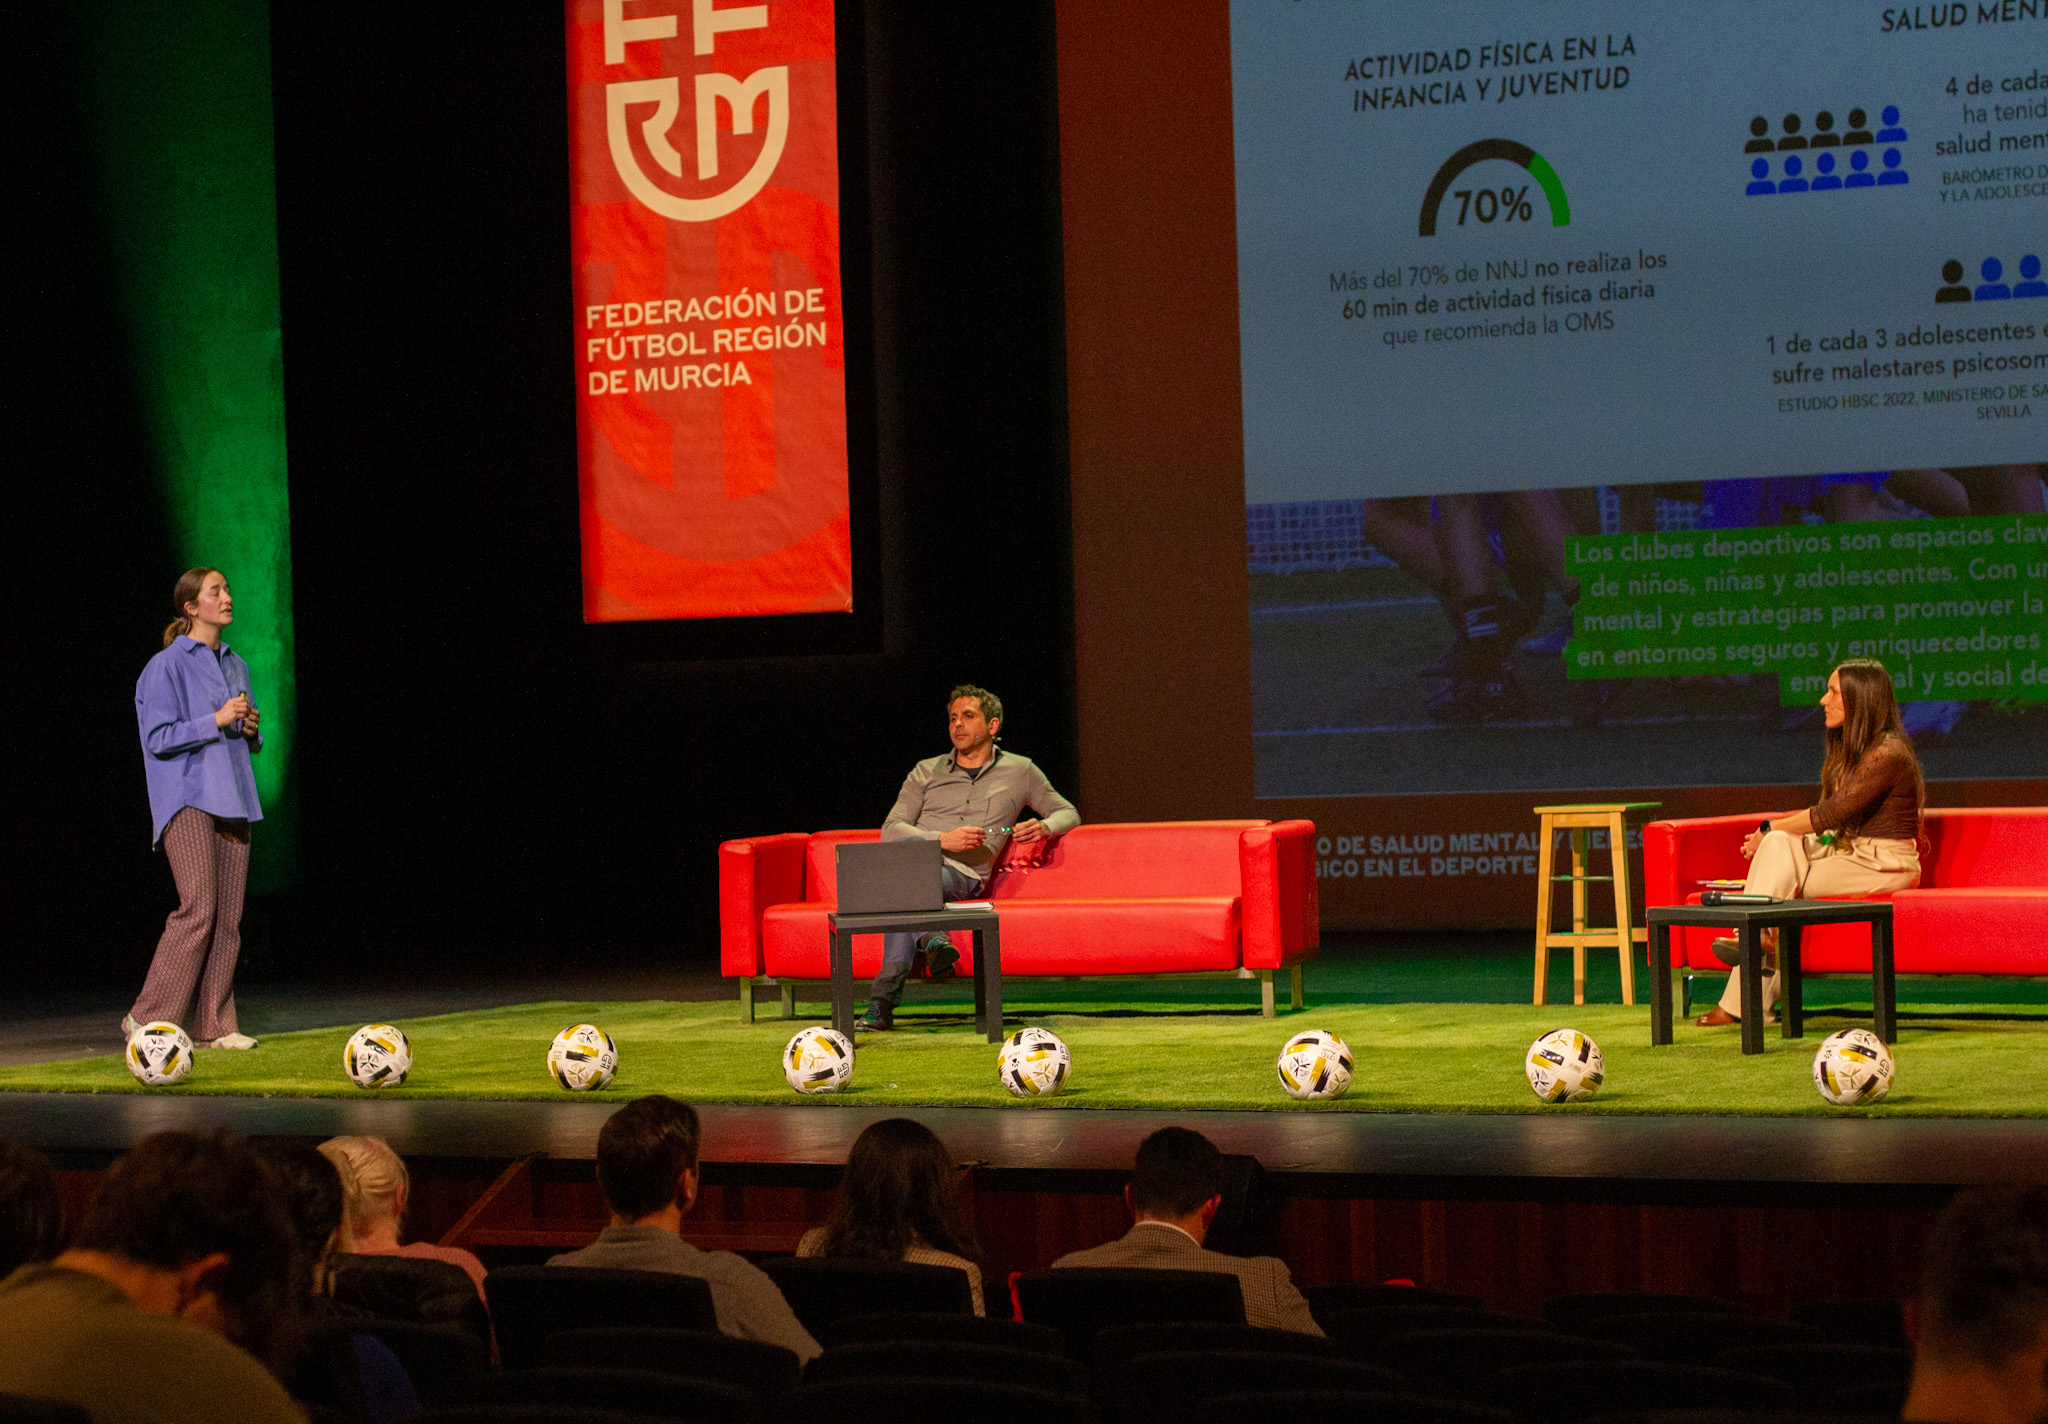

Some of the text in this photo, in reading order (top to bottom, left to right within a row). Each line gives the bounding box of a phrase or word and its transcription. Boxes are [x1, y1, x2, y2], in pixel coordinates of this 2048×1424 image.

[1882, 3, 1967, 32] SALUD
[1344, 33, 1636, 82] ACTIVIDAD FÍSICA EN LA
[1353, 66, 1630, 112] INFANCIA Y JUVENTUD
[1946, 69, 2048, 95] 4 de cada
[1963, 103, 1987, 124] ha
[1936, 131, 2048, 156] salud men
[1942, 165, 2033, 185] BARÓMETRO
[1454, 186, 1533, 226] 70%
[1939, 189, 1949, 202] Y
[1952, 187, 1969, 202] LA
[1330, 249, 1667, 293] Más del 70% de NNJ no realiza los
[586, 288, 825, 329] FEDERACIÓN DE
[1342, 280, 1655, 320] 60 min de actividad física diaria
[587, 318, 827, 362] FÚTBOL REGIÓN
[1382, 311, 1615, 348] que recomienda la OMS
[1767, 336, 1776, 354] 1
[1786, 333, 1811, 354] de
[1819, 329, 1868, 351] cada
[1876, 329, 1887, 348] 3
[1895, 323, 2035, 347] adolescentes
[588, 362, 752, 395] DE MURCIA
[1773, 362, 1824, 385] sufre
[1832, 358, 1945, 381] malestares
[1778, 396, 1838, 413] ESTUDIO
[1841, 394, 1878, 409] HBSC
[1923, 387, 2005, 404] MINISTERIO
[2008, 385, 2027, 399] DE
[1977, 405, 2032, 420] SEVILLA
[1573, 542, 1613, 563] Los
[1620, 537, 1694, 562] clubes
[1703, 532, 1832, 562] deportivos
[1839, 532, 1881, 551] son
[1890, 524, 1994, 552] espacios
[1590, 573, 1619, 597] de
[1627, 573, 1696, 596] niños,
[1705, 568, 1766, 592] niñas
[1773, 571, 1786, 595] y
[1793, 563, 1959, 588] adolescentes.
[1969, 558, 2017, 581] Con
[1583, 590, 2043, 633] mental y estrategias para promover la
[1577, 628, 2040, 666] en entornos seguros y enriquecedores
[1922, 671, 1936, 694] y
[1943, 663, 2012, 688] social
[1337, 836, 1364, 853] DE
[1370, 834, 1445, 852] SALUD
[1450, 832, 1539, 851] MENTAL
[1317, 855, 1538, 878] ICO EN EL DEPORTE
